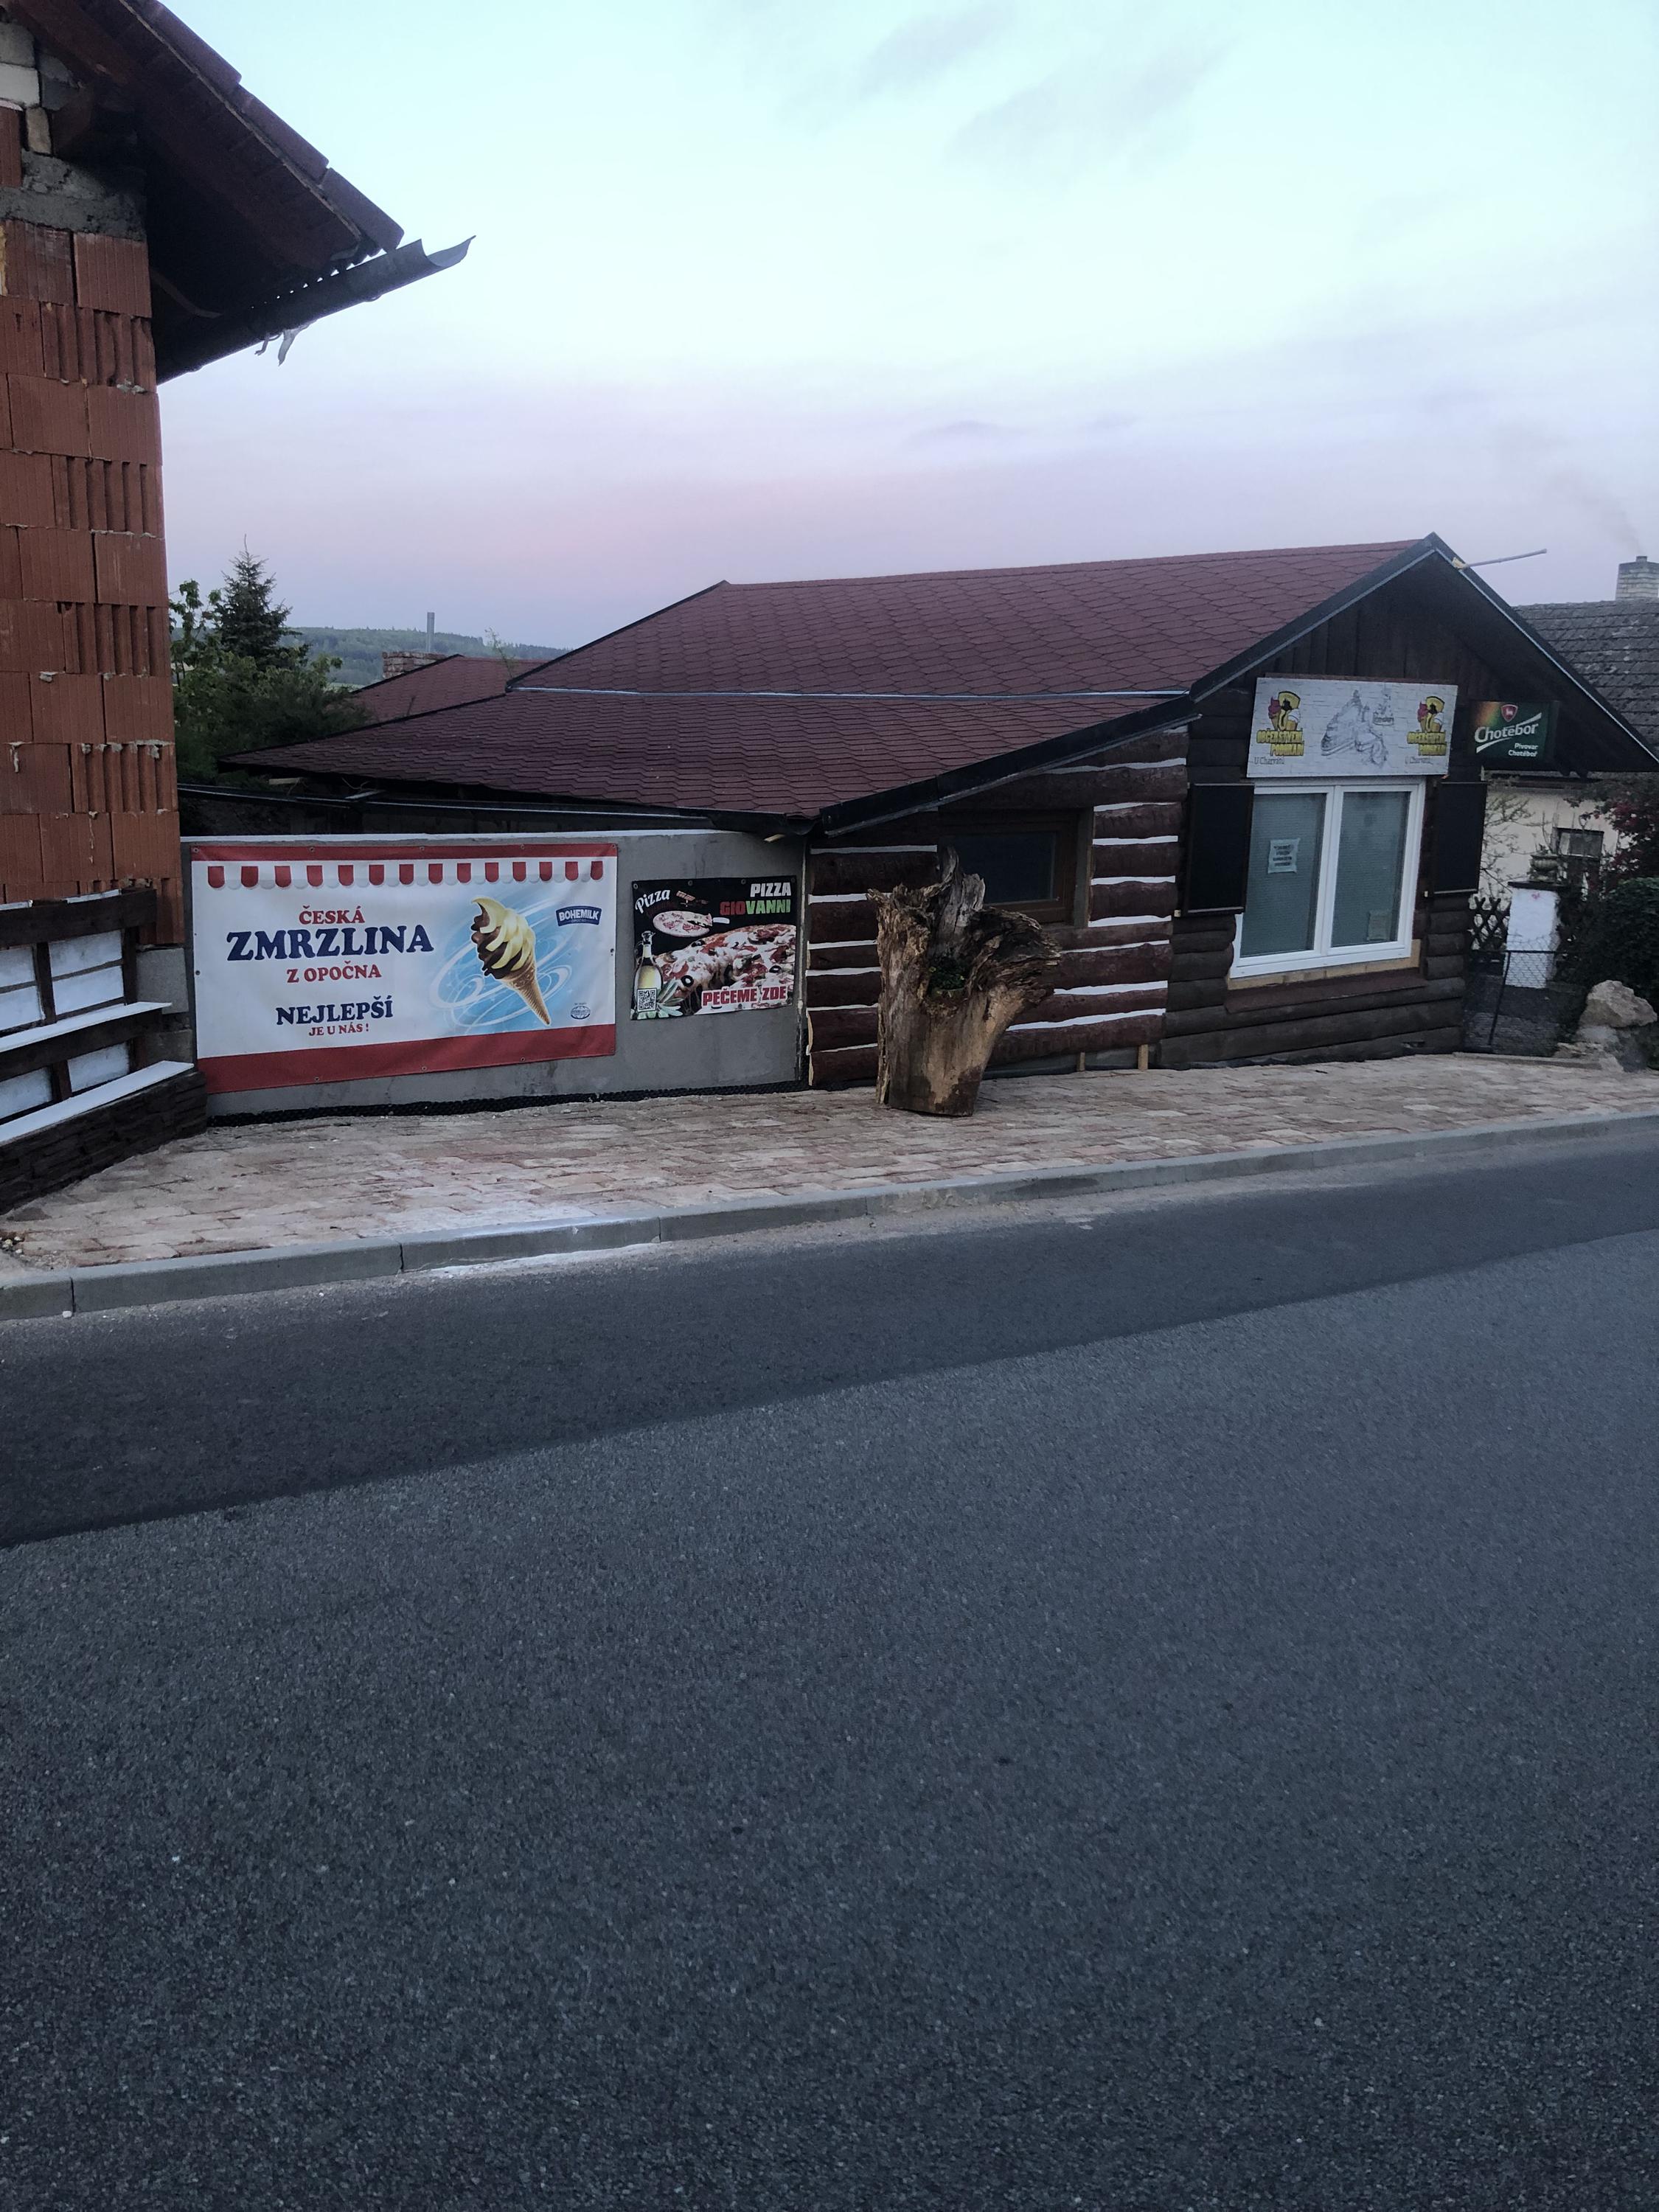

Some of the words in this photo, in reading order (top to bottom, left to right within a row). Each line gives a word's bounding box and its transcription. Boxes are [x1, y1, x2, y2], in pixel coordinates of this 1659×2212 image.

[750, 882, 791, 898] PIZZA
[635, 889, 671, 914] Pizza
[720, 899, 791, 916] GIOVANNI
[299, 905, 365, 925] ČESKÁ
[558, 908, 599, 922] BOHEMILK
[226, 924, 434, 961] ZMRZLINA
[287, 969, 299, 983] Z
[304, 961, 382, 982] OPOČNA
[702, 986, 757, 1006] PEČEME
[761, 986, 787, 1001] ZDE
[276, 995, 394, 1026] NEJLEPŠÍ
[309, 1026, 324, 1036] JE
[326, 1026, 336, 1035] U
